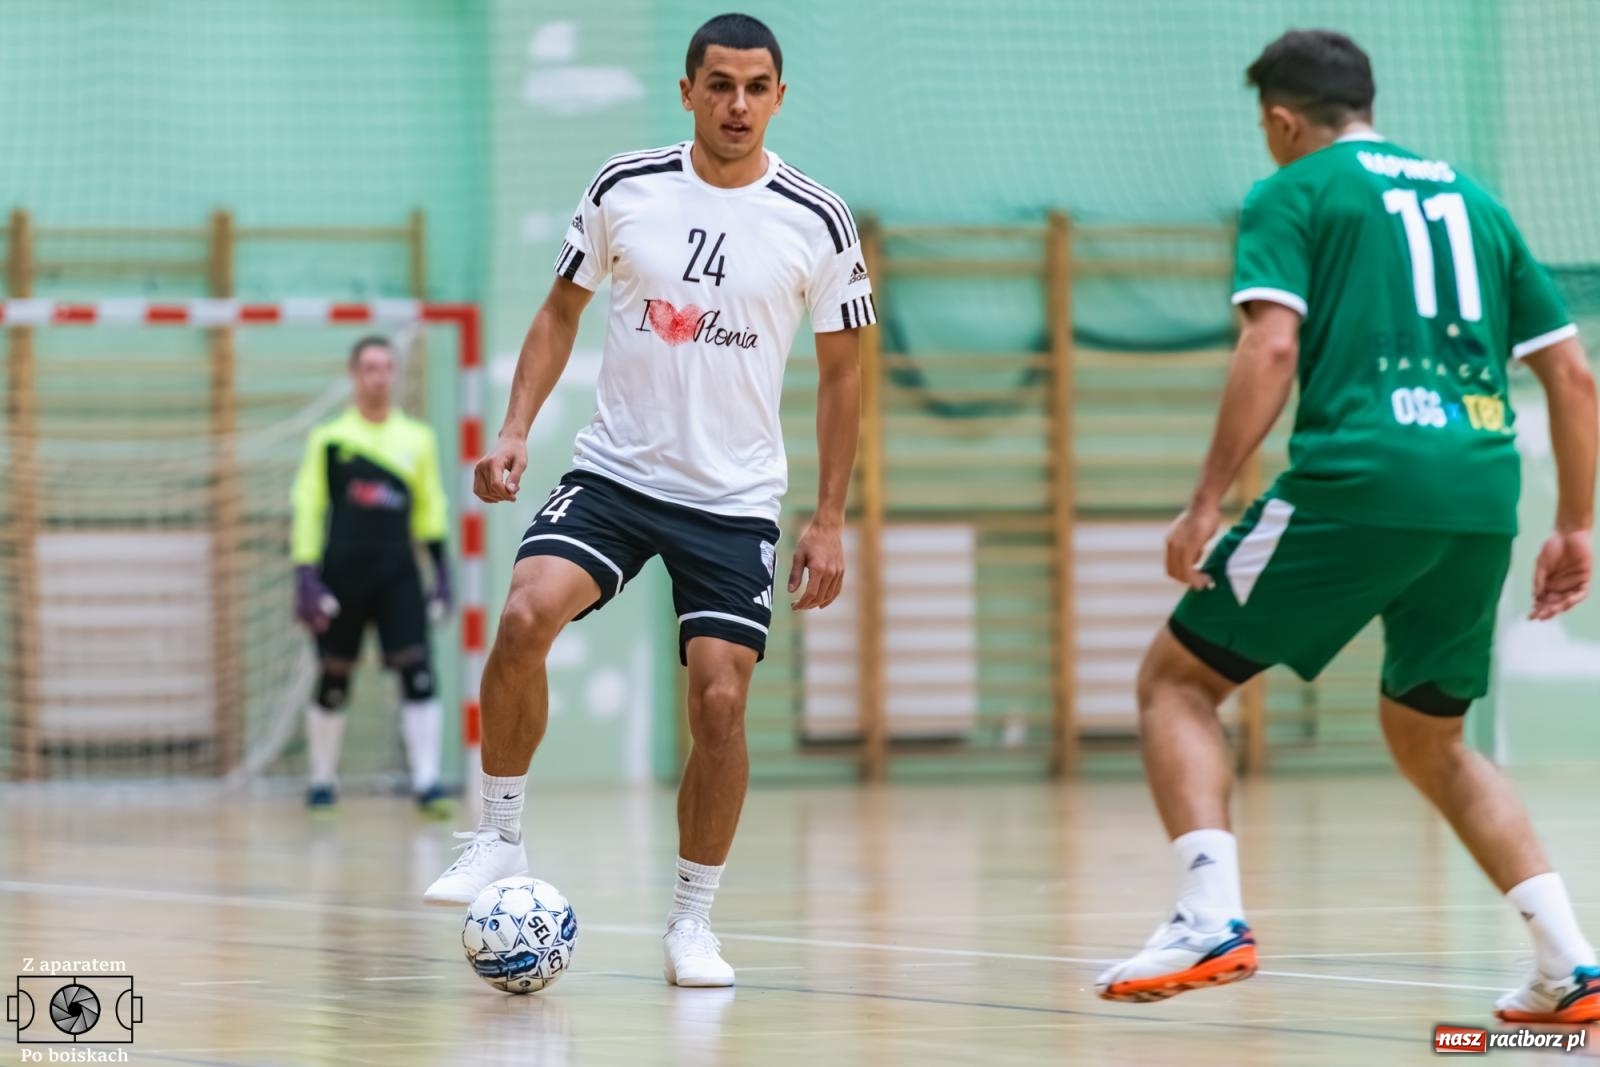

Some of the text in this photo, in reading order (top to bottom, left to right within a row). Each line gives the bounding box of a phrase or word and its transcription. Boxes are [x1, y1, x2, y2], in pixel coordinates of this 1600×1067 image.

[682, 228, 726, 286] 24
[1382, 188, 1481, 321] 11
[635, 298, 758, 349] I Płonia
